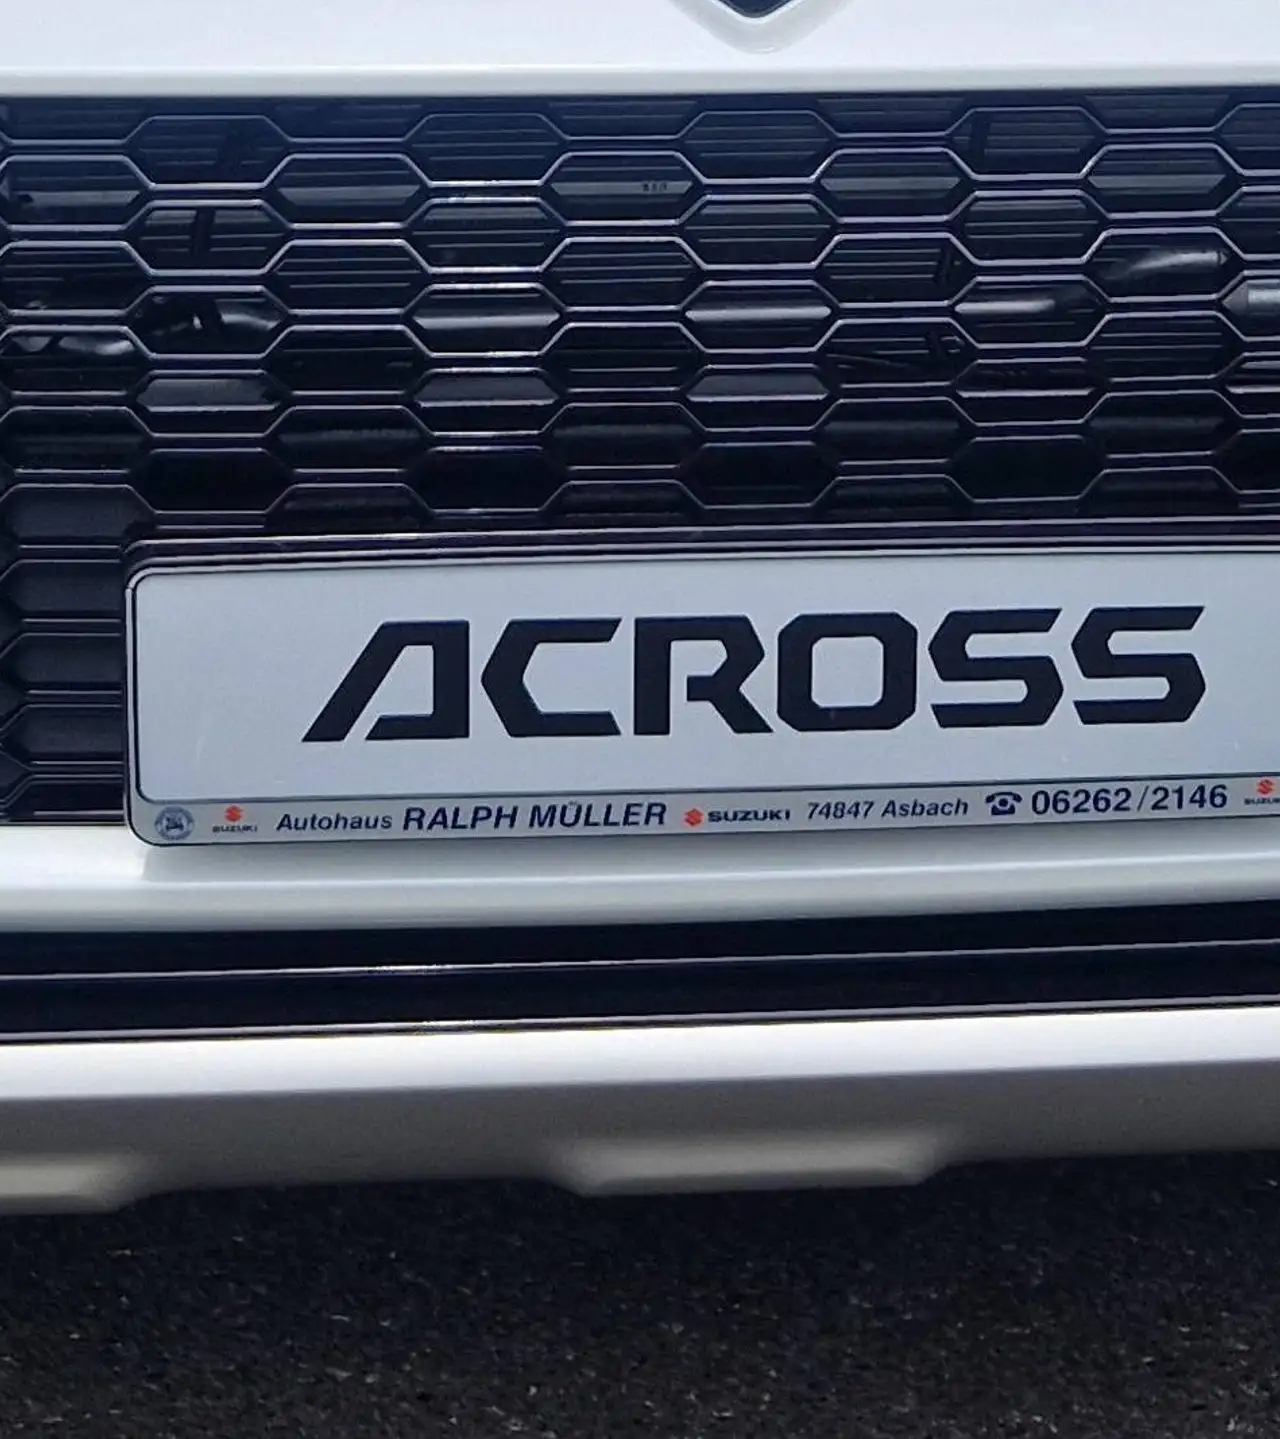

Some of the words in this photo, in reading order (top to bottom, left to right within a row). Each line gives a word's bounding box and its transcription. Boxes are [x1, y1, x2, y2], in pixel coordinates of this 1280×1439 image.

[300, 605, 1207, 743] ACROSS
[275, 812, 394, 832] Autohaus
[402, 804, 519, 832] RALPH
[528, 799, 668, 829] MÜLLER
[707, 807, 791, 823] SUZUKI
[807, 800, 875, 821] 74847
[880, 798, 970, 819] Asbach
